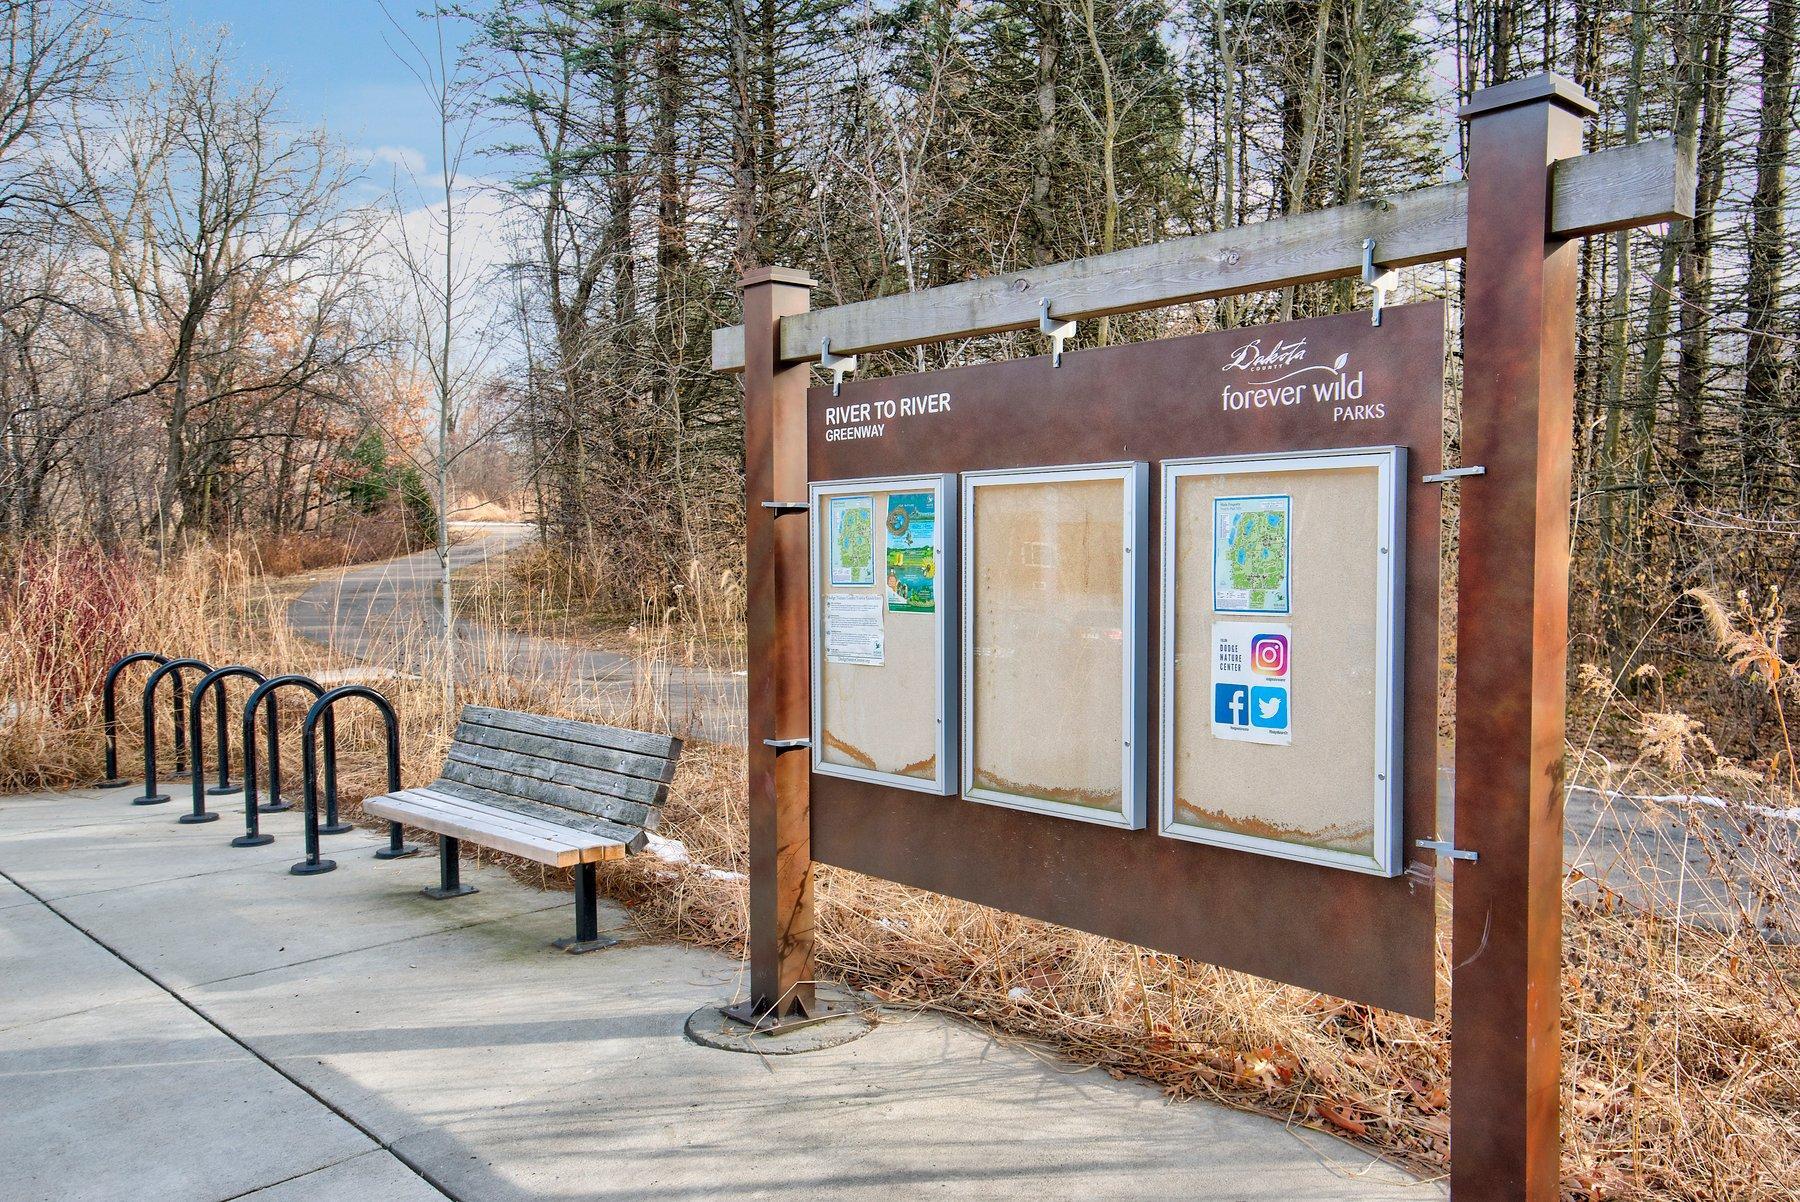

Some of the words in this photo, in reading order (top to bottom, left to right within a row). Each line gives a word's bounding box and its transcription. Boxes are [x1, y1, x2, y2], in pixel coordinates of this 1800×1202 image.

[1222, 337, 1307, 371] Dakota
[1251, 364, 1283, 372] COUNTY
[1222, 385, 1306, 411] forever
[1312, 371, 1363, 402] wild
[826, 403, 870, 425] RIVER
[874, 400, 896, 419] TO
[901, 392, 951, 417] RIVER
[1334, 403, 1386, 422] PARKS
[826, 424, 885, 442] GREENWAY
[1220, 644, 1238, 653] DODGE
[1220, 653, 1242, 663] NATURE
[1220, 662, 1242, 672] CENTER
